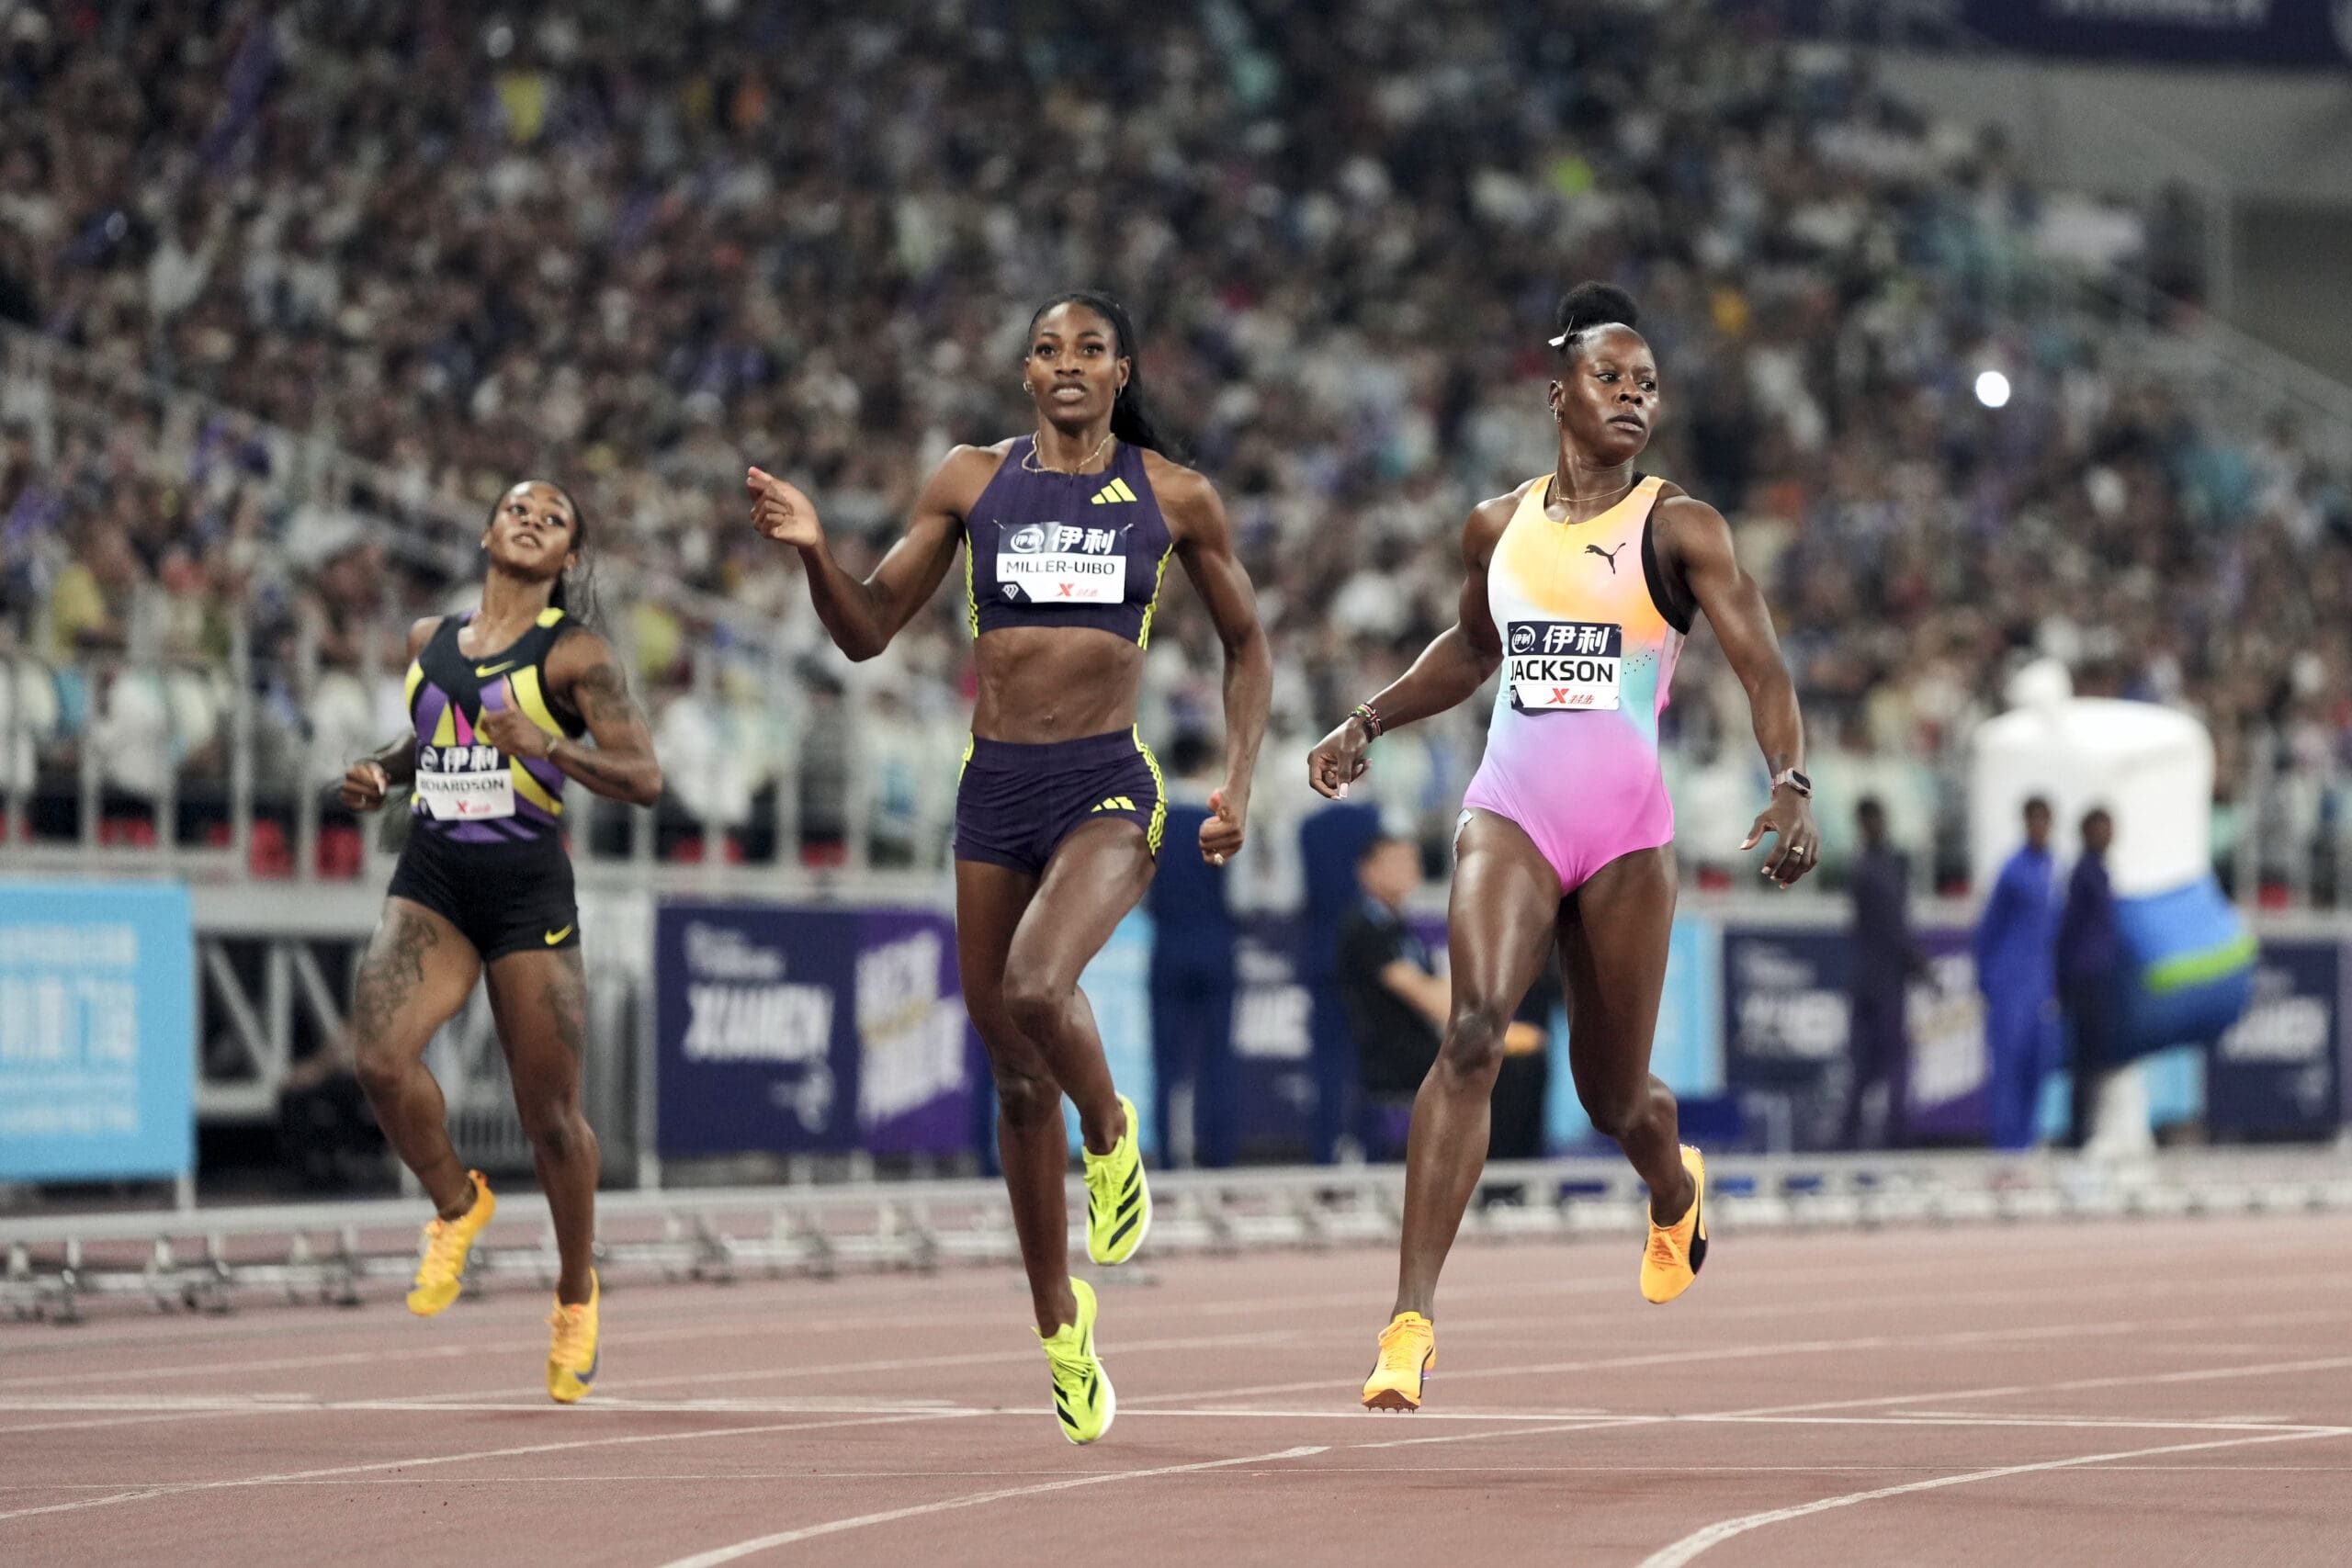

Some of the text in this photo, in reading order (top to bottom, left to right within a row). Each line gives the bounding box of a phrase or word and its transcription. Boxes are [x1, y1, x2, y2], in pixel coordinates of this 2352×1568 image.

[1051, 525, 1116, 555] 伊利
[1006, 560, 1115, 575] MILLER-UIBO
[1514, 633, 1532, 646] 伊利
[1543, 625, 1611, 655] 伊利
[1510, 660, 1613, 682] JACKSON
[442, 746, 499, 773] 伊利
